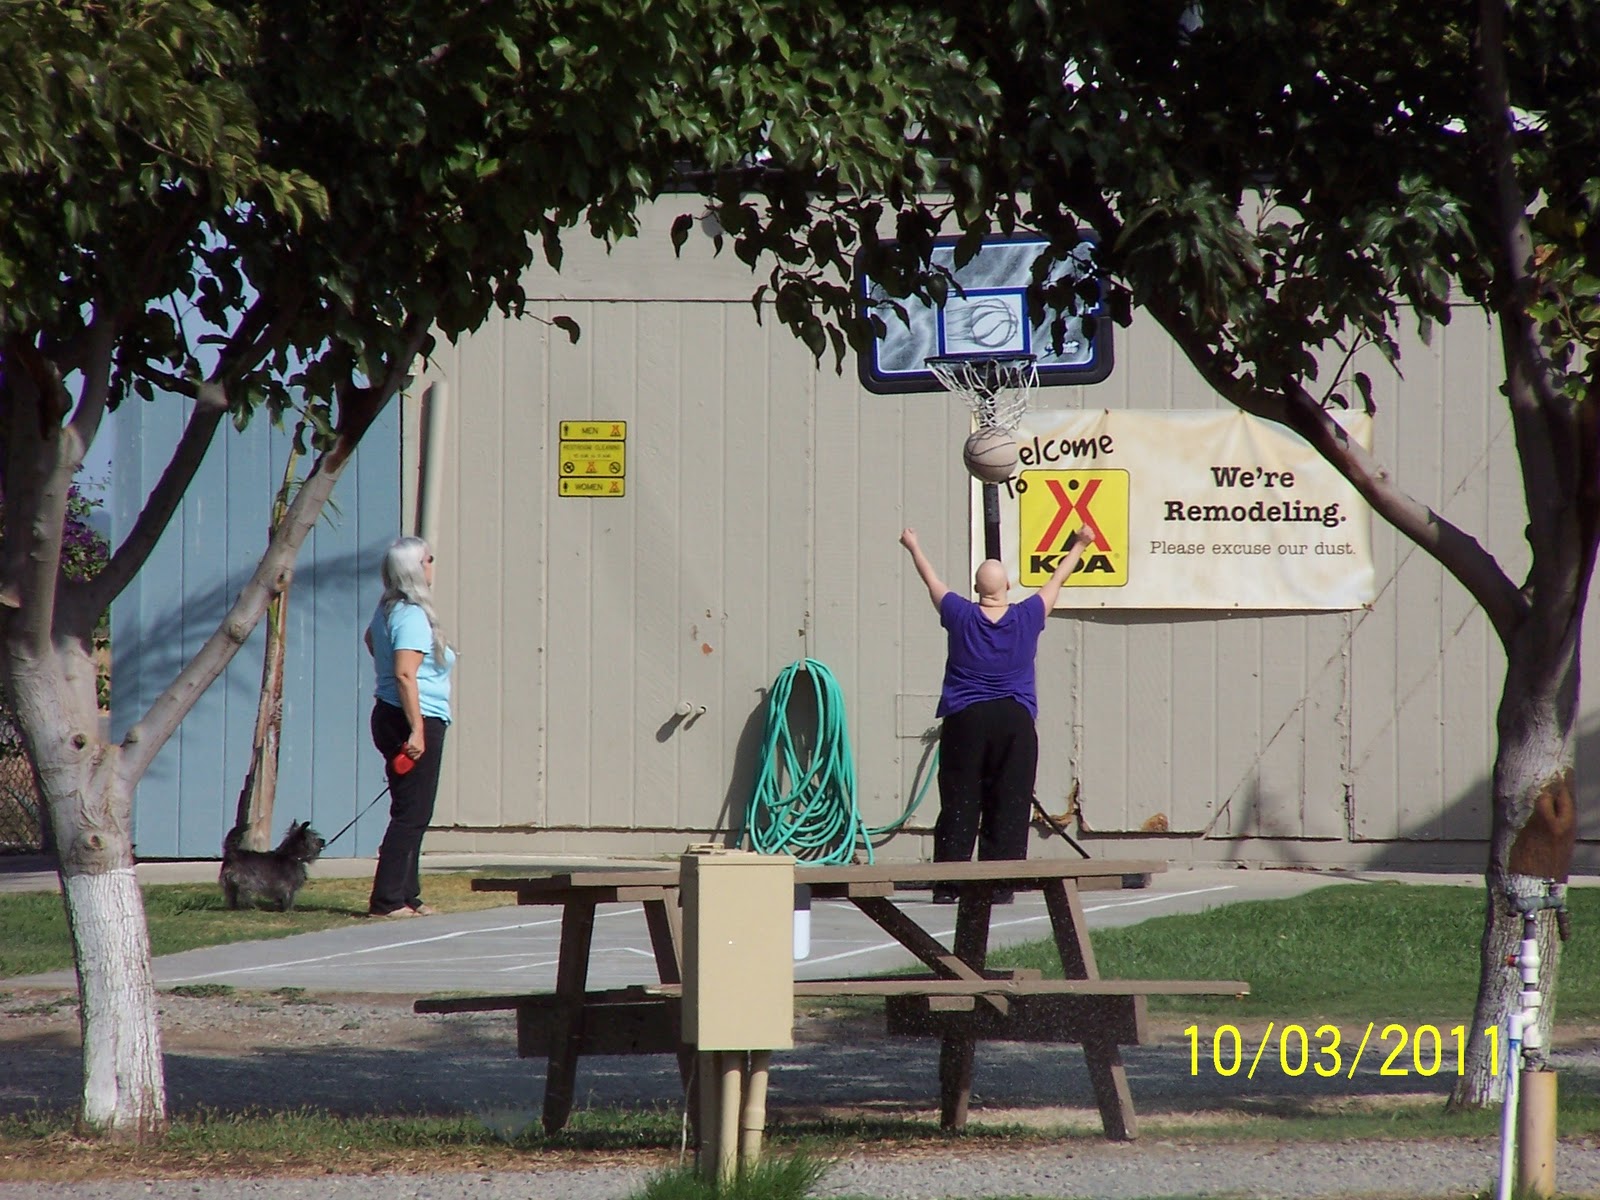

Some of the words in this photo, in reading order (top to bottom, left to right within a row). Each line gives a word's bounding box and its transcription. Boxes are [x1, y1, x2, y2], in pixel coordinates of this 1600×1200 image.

[1019, 435, 1114, 465] elcome
[575, 483, 603, 491] WOMEN
[1210, 467, 1295, 488] We're
[1164, 500, 1347, 528] Remodeling.
[1150, 541, 1206, 555] Please
[1211, 543, 1276, 555] excuse
[1277, 543, 1308, 555] our
[1314, 541, 1356, 555] dust.
